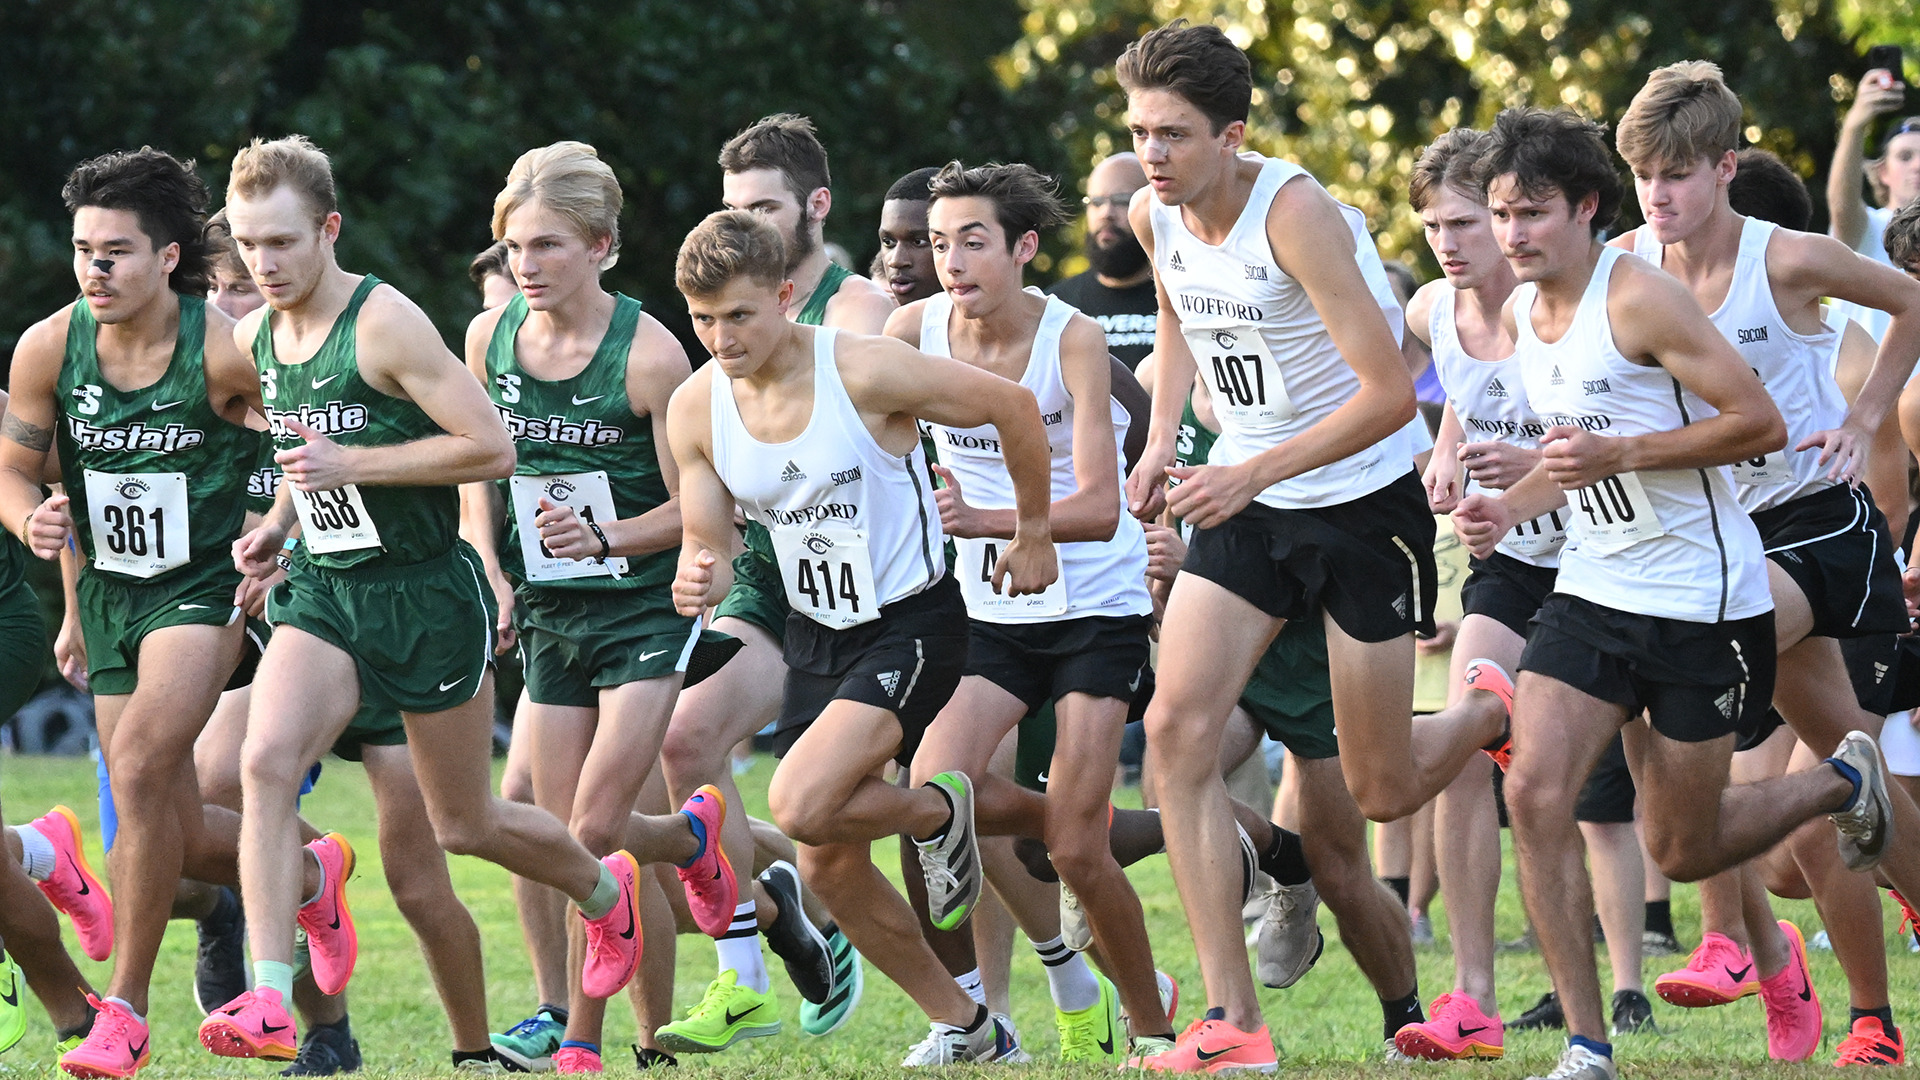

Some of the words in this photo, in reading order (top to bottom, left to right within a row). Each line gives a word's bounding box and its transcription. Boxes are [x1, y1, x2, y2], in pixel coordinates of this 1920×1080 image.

[1245, 265, 1268, 281] SOCON
[1180, 294, 1263, 322] WOFFORD
[1738, 326, 1768, 345] SOCON
[1211, 354, 1266, 407] 407
[1583, 378, 1611, 396] SOCON
[66, 412, 205, 454] Upstate
[114, 480, 124, 492] EYE
[125, 476, 151, 492] OPENER
[543, 481, 553, 493] EYE
[551, 478, 577, 492] OPENER
[781, 473, 807, 482] adidas
[831, 466, 862, 487] SOCON
[302, 488, 361, 532] 358
[764, 503, 858, 526] WOFFORD
[1579, 475, 1636, 526] 410
[104, 505, 165, 559] 361
[798, 558, 860, 613] 414
[888, 669, 901, 697] adidas
[1725, 687, 1735, 720] adidas
